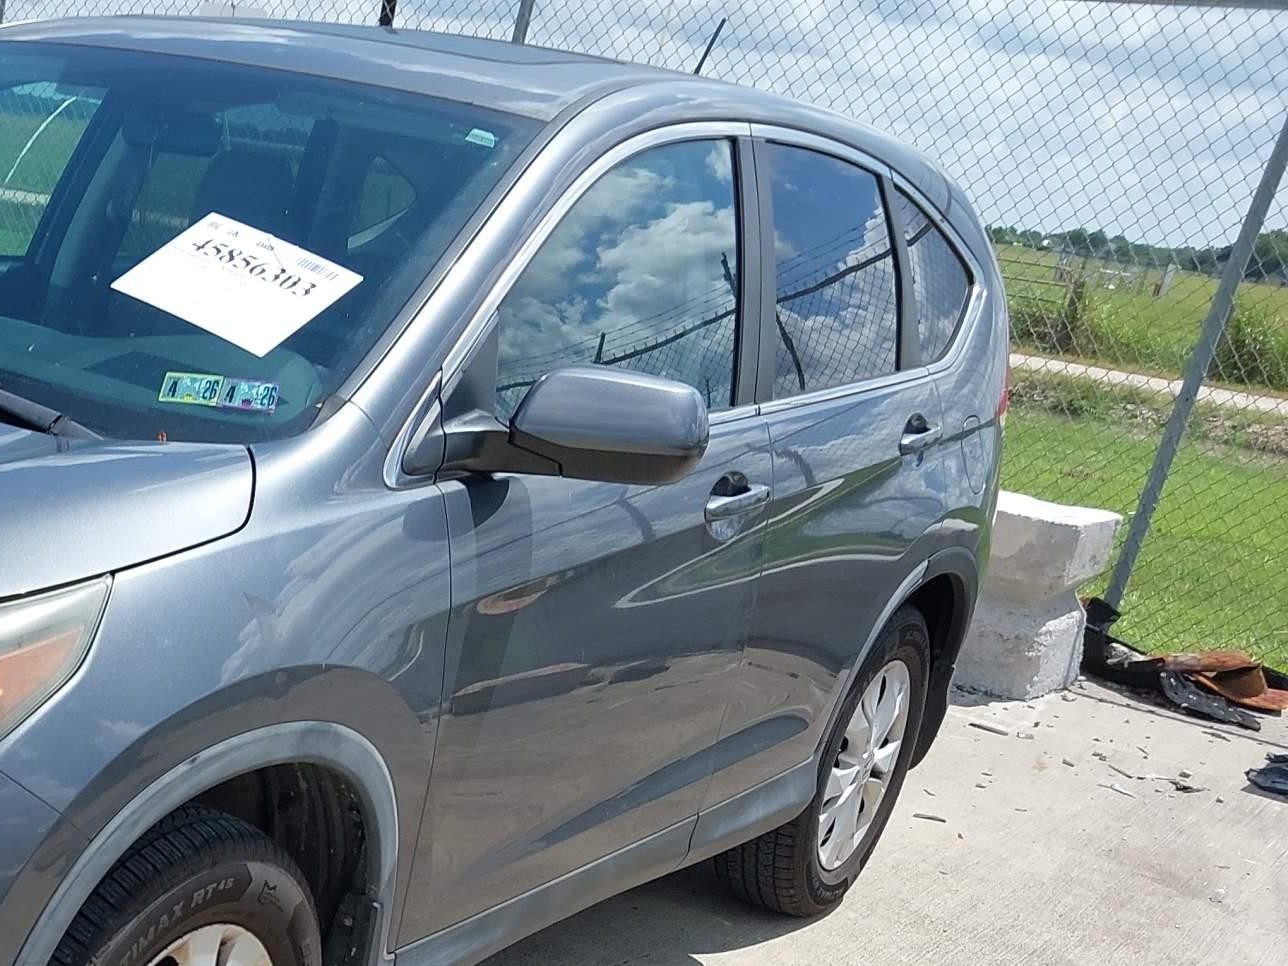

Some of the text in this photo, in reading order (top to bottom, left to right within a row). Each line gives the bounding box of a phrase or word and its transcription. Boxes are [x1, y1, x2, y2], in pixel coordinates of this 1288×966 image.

[192, 238, 317, 297] 45856303
[166, 379, 220, 401] 4 26
[223, 385, 278, 407] 4 26
